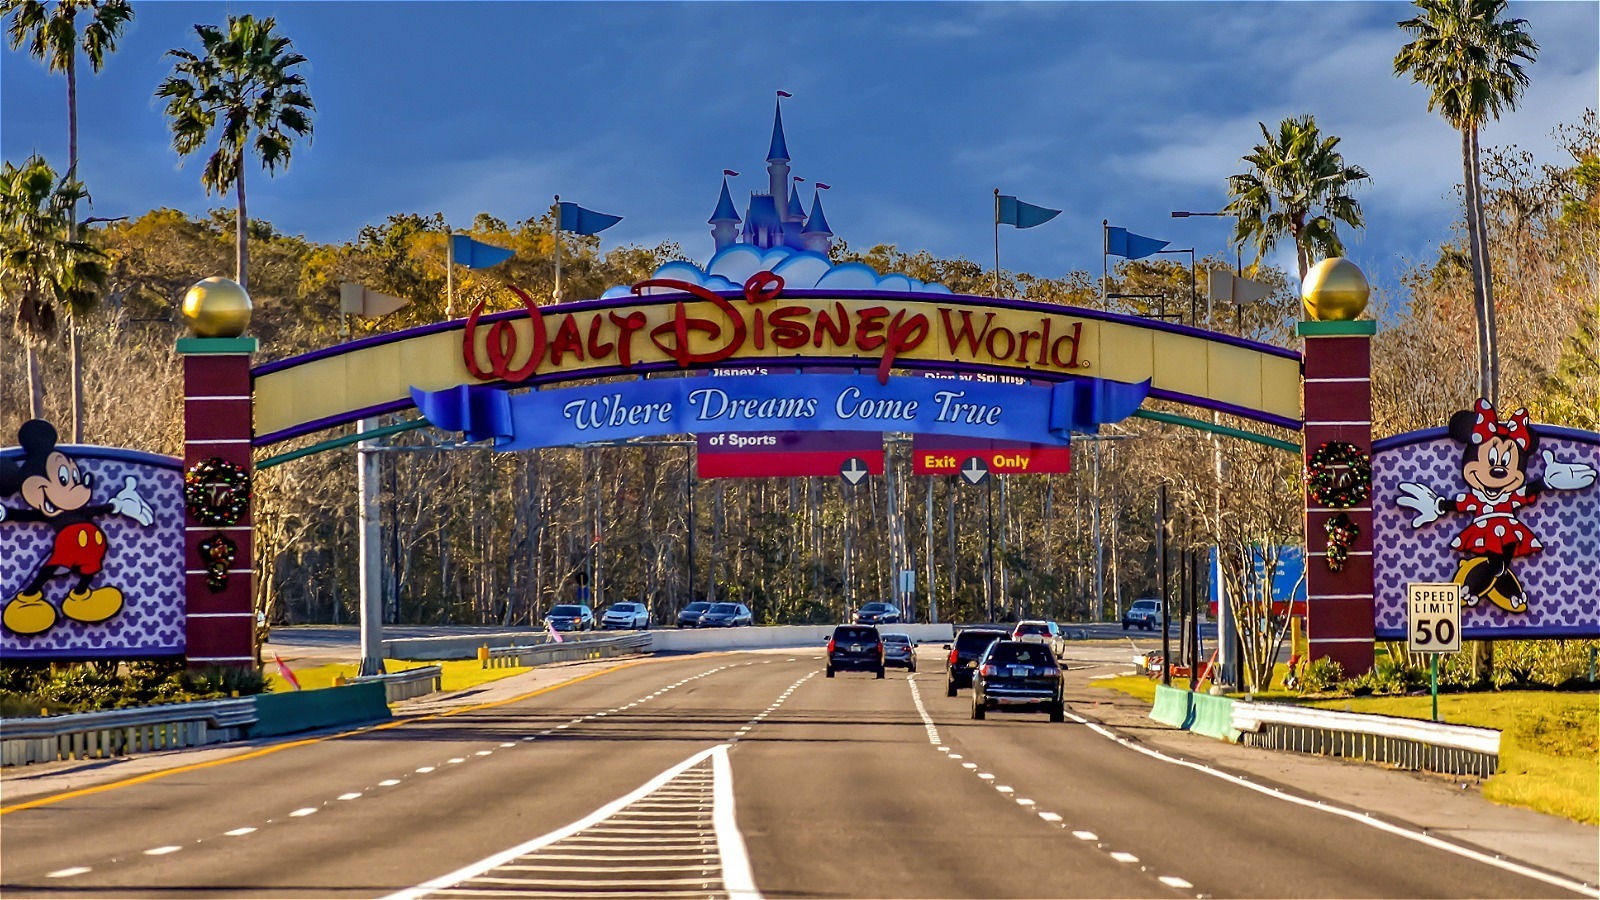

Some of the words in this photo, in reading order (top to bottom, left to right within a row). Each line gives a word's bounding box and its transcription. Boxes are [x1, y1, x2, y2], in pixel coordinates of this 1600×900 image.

[937, 308, 1083, 369] World
[977, 373, 1026, 385] Sping
[563, 394, 672, 430] Where
[688, 388, 818, 420] Dreams
[835, 386, 918, 420] Come
[934, 390, 1002, 425] True
[709, 434, 725, 446] of
[728, 433, 777, 448] Sports
[925, 455, 956, 468] Exit
[993, 454, 1029, 469] Only
[1415, 591, 1454, 602] SPEED
[1415, 603, 1454, 613] LIMIT
[1415, 618, 1455, 645] 50
